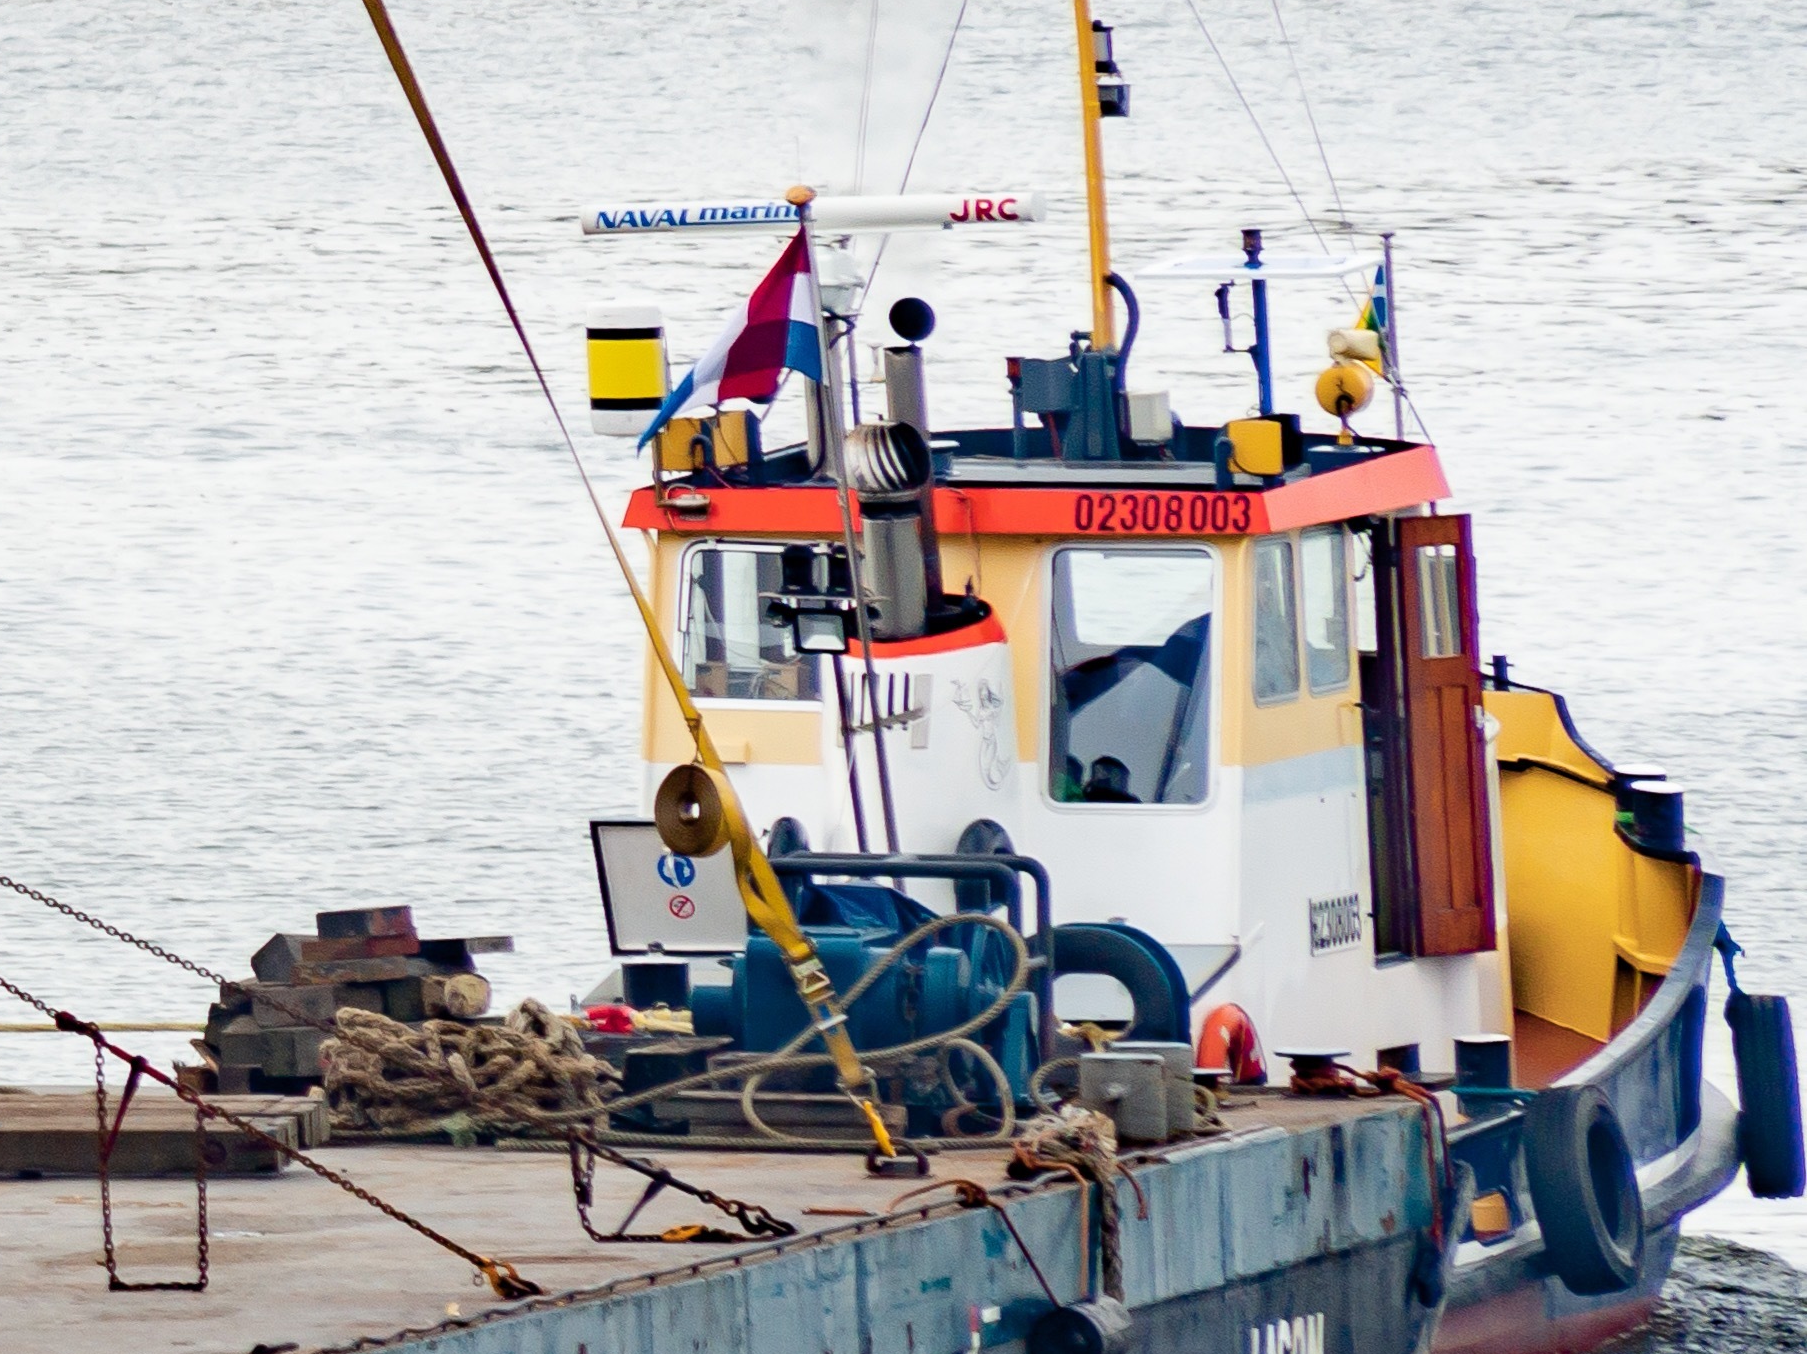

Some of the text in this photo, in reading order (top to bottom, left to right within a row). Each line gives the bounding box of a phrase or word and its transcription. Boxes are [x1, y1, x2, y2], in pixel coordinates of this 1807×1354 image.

[596, 208, 689, 230] NAVAL
[950, 198, 1019, 222] JRC
[1075, 494, 1251, 532] 02308003
